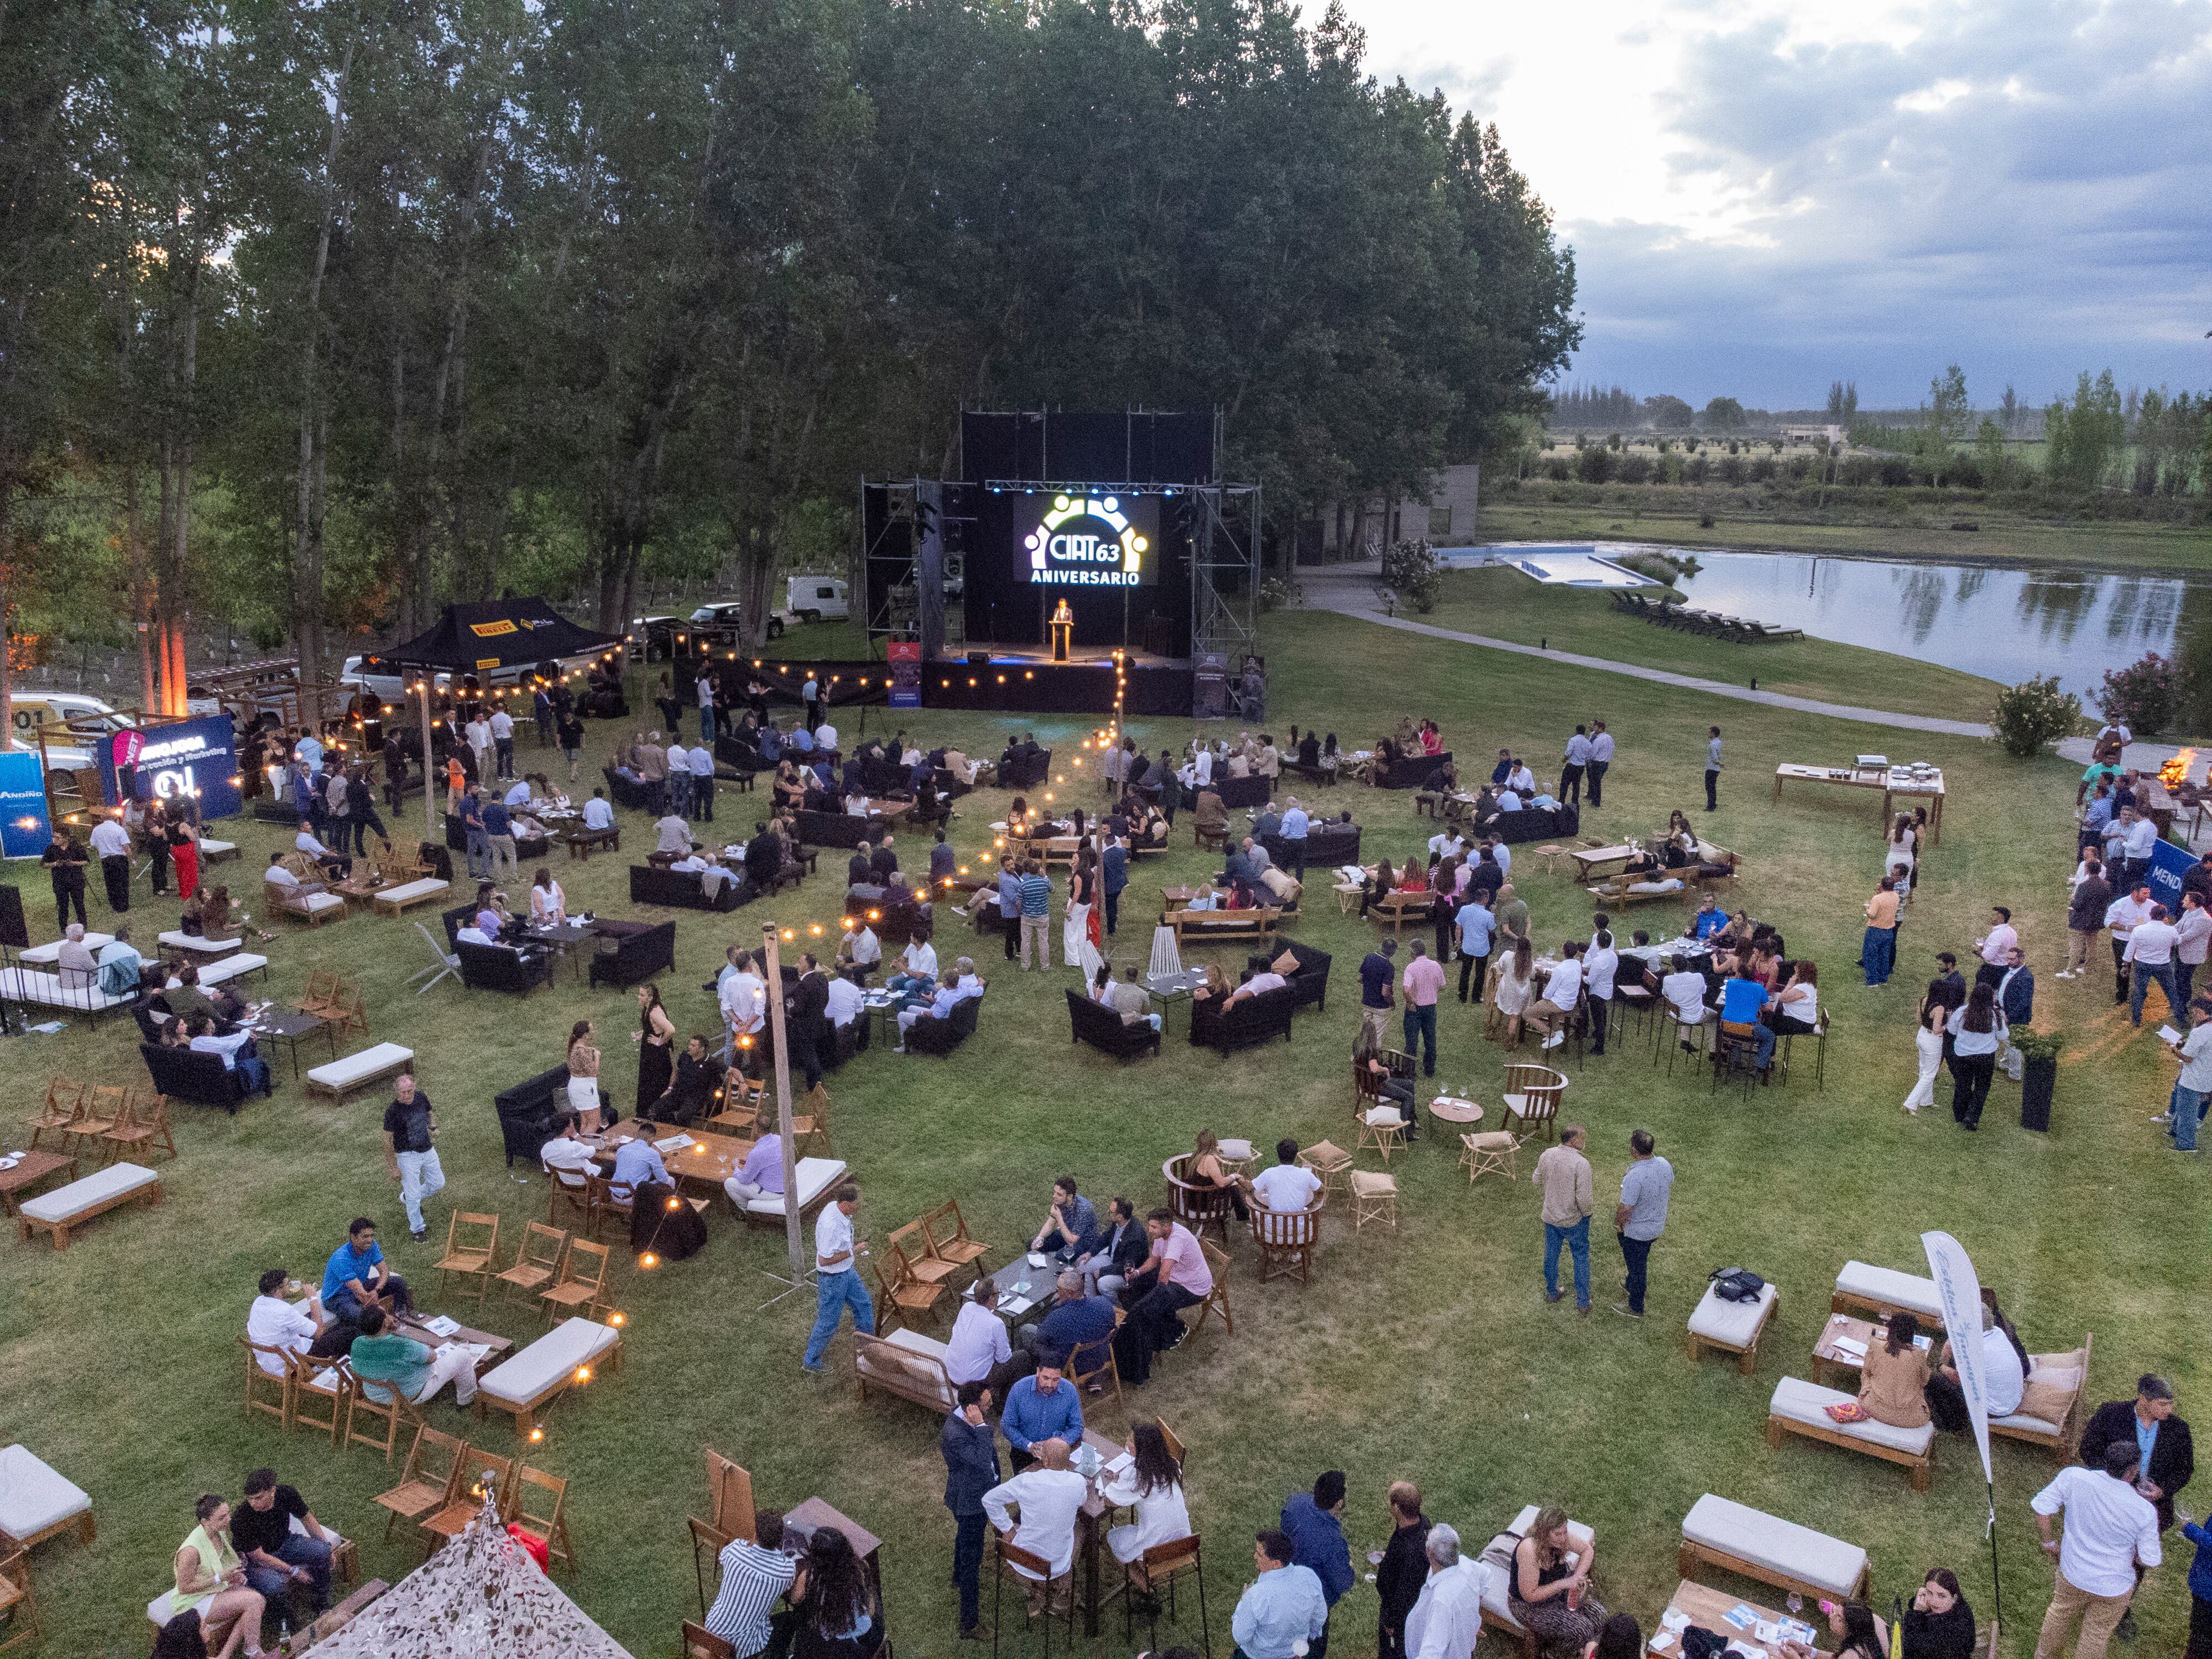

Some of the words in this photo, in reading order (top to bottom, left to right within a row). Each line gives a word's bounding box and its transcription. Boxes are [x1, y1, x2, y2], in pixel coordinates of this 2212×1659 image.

[1050, 534, 1099, 561] CIAT
[1095, 544, 1120, 562] 63
[1031, 570, 1139, 585] ANIVERSARIO
[476, 623, 512, 634] PIRELLI
[2152, 866, 2182, 891] MEND
